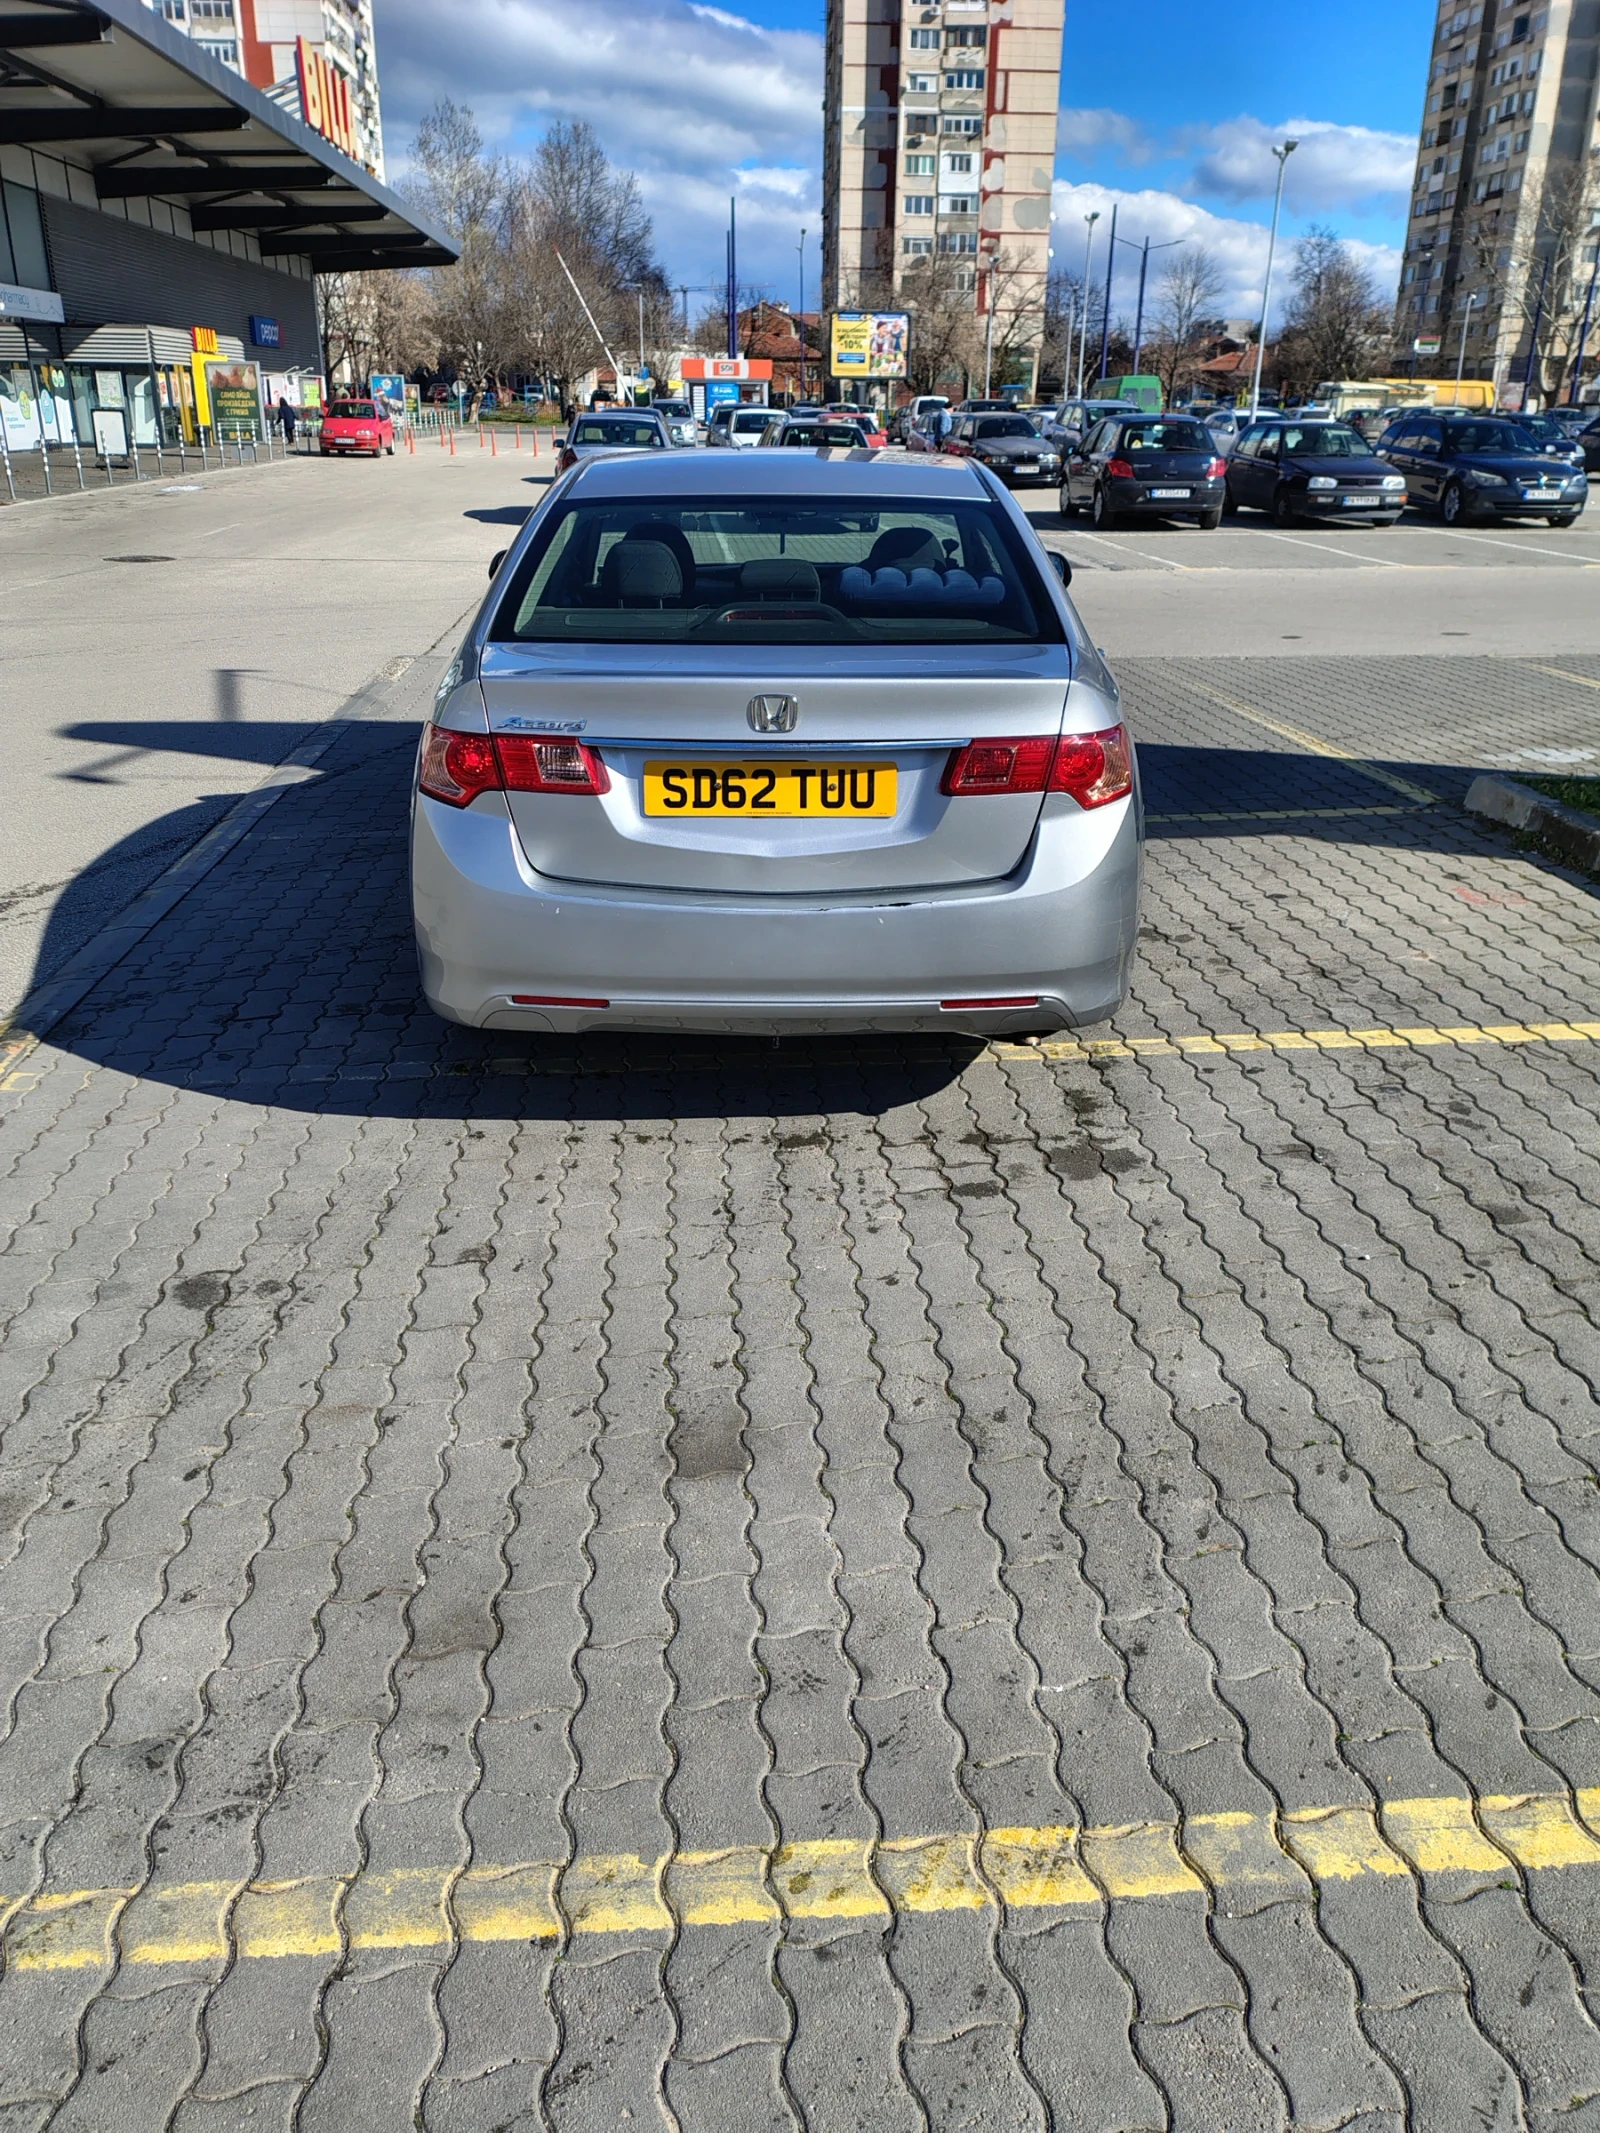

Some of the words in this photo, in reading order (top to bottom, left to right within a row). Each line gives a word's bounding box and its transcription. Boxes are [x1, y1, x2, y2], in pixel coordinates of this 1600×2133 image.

[296, 34, 360, 161] BILLA
[192, 325, 218, 352] BILLA
[260, 323, 279, 344] pepco
[840, 339, 863, 349] -10%
[220, 391, 235, 399] САМО
[496, 716, 587, 732] Accord
[662, 768, 776, 809] SD62
[791, 768, 875, 809] TUU
